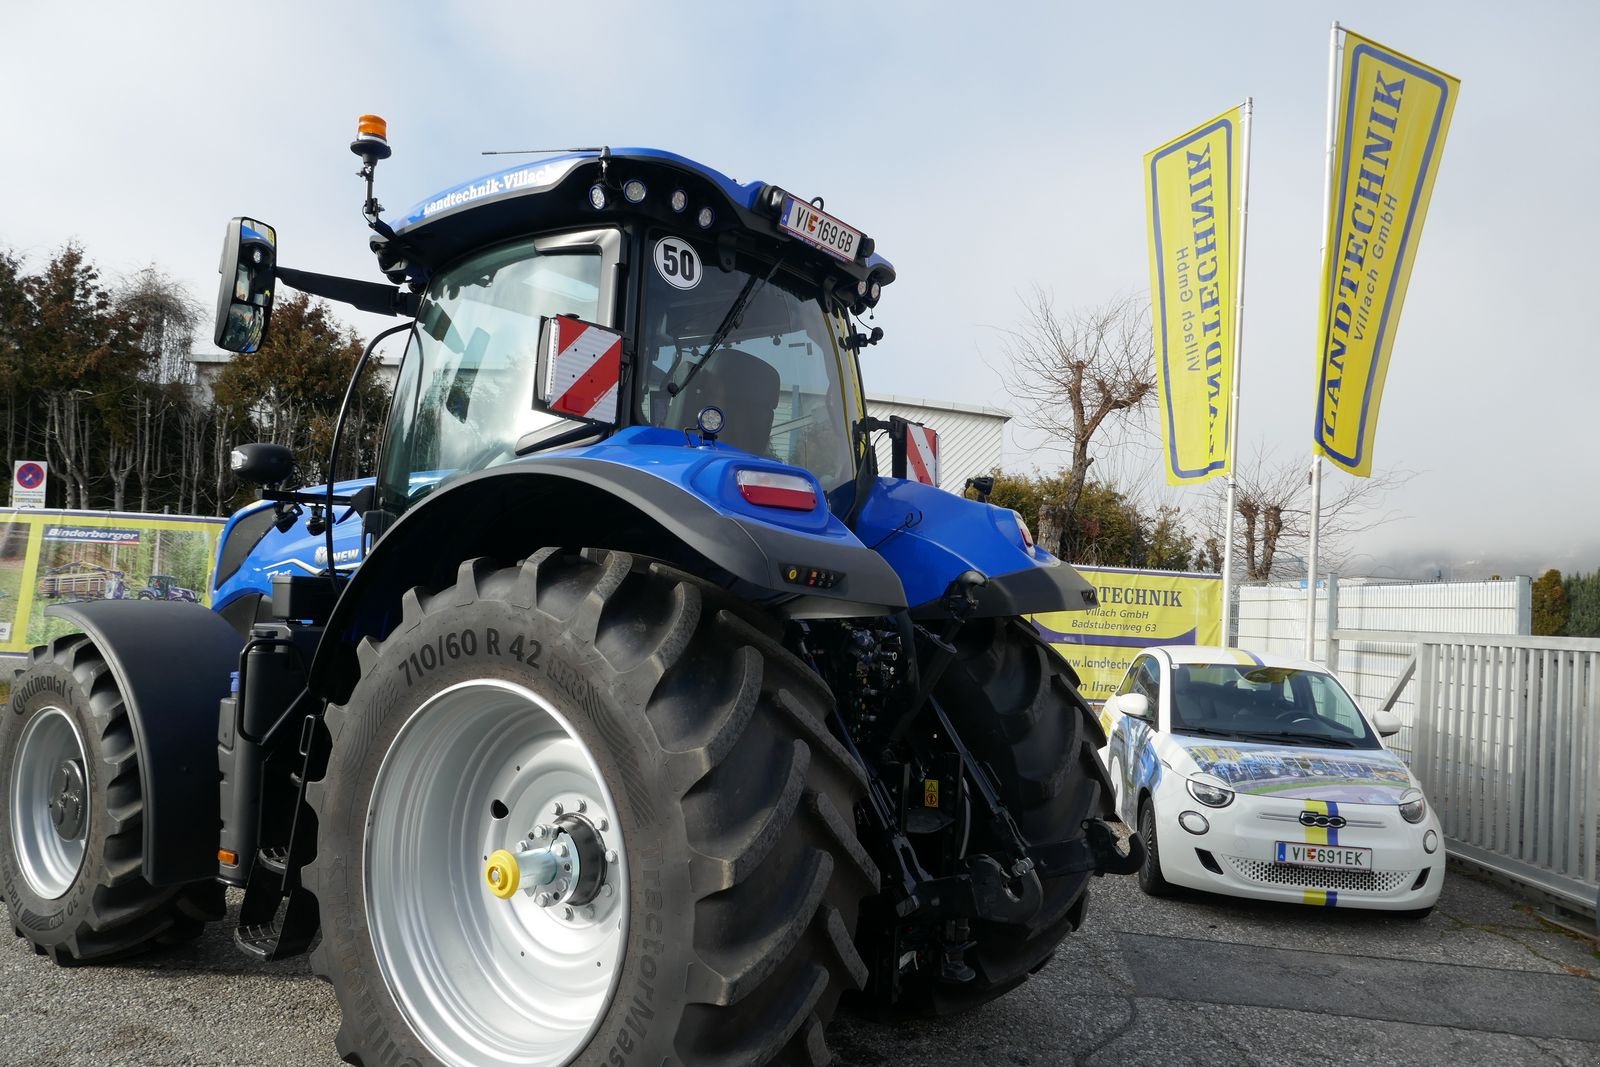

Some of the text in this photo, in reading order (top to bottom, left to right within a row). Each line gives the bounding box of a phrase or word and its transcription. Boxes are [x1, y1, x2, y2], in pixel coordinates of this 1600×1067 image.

[663, 243, 695, 282] 50
[1323, 69, 1406, 442] LANDTECHNIK
[1354, 193, 1398, 341] Villach GmbH
[47, 527, 138, 542] Binderberger
[333, 548, 360, 562] NEW
[1093, 586, 1183, 607] TECHNIK
[1071, 619, 1157, 633] Badstubenweg 63
[1086, 608, 1150, 619] Villach GmbH
[398, 628, 543, 687] 710/60 R 42
[12, 674, 67, 716] Continental
[1299, 810, 1347, 829] 500
[602, 838, 665, 1067] TractorMas
